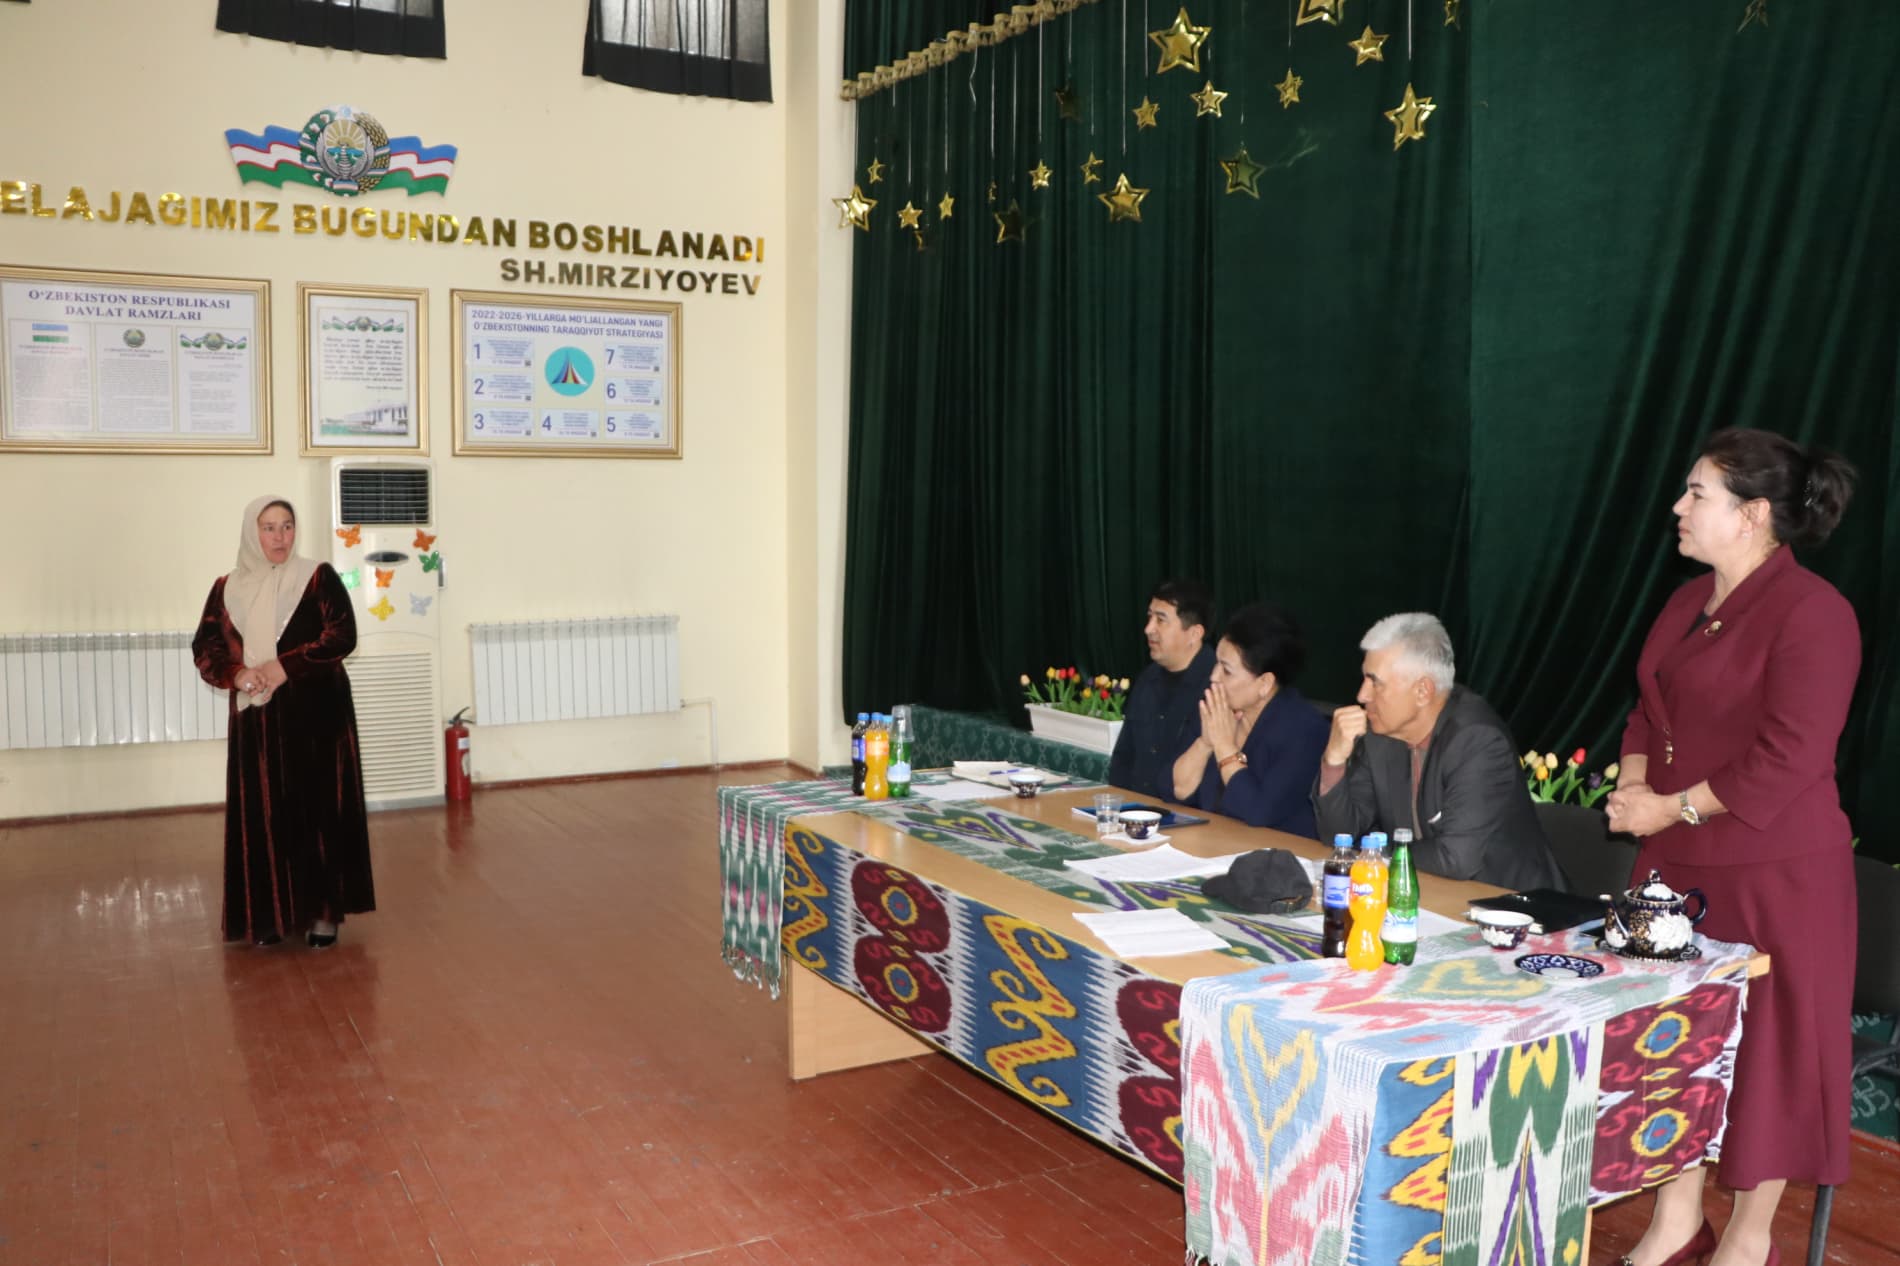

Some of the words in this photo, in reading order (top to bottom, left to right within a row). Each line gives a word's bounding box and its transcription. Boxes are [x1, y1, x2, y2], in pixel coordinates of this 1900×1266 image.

[293, 204, 516, 248] BUGUNDAN
[529, 219, 765, 262] BOSHLANADI
[500, 258, 762, 295] SH.MIRZIYOYEV
[132, 295, 231, 309] RESPUBLIKASI
[65, 305, 123, 317] DAVLAT
[128, 308, 202, 321] RAMZLARI
[638, 317, 664, 327] YANGI
[552, 326, 603, 337] TARAQQIYOT
[606, 328, 664, 339] STRATEGIYASI
[474, 343, 481, 360] 1
[605, 348, 615, 365] 7
[474, 378, 484, 395] 2
[607, 383, 616, 399] 6
[474, 413, 485, 430] 3
[542, 416, 552, 431] 4
[607, 417, 616, 432] 5
